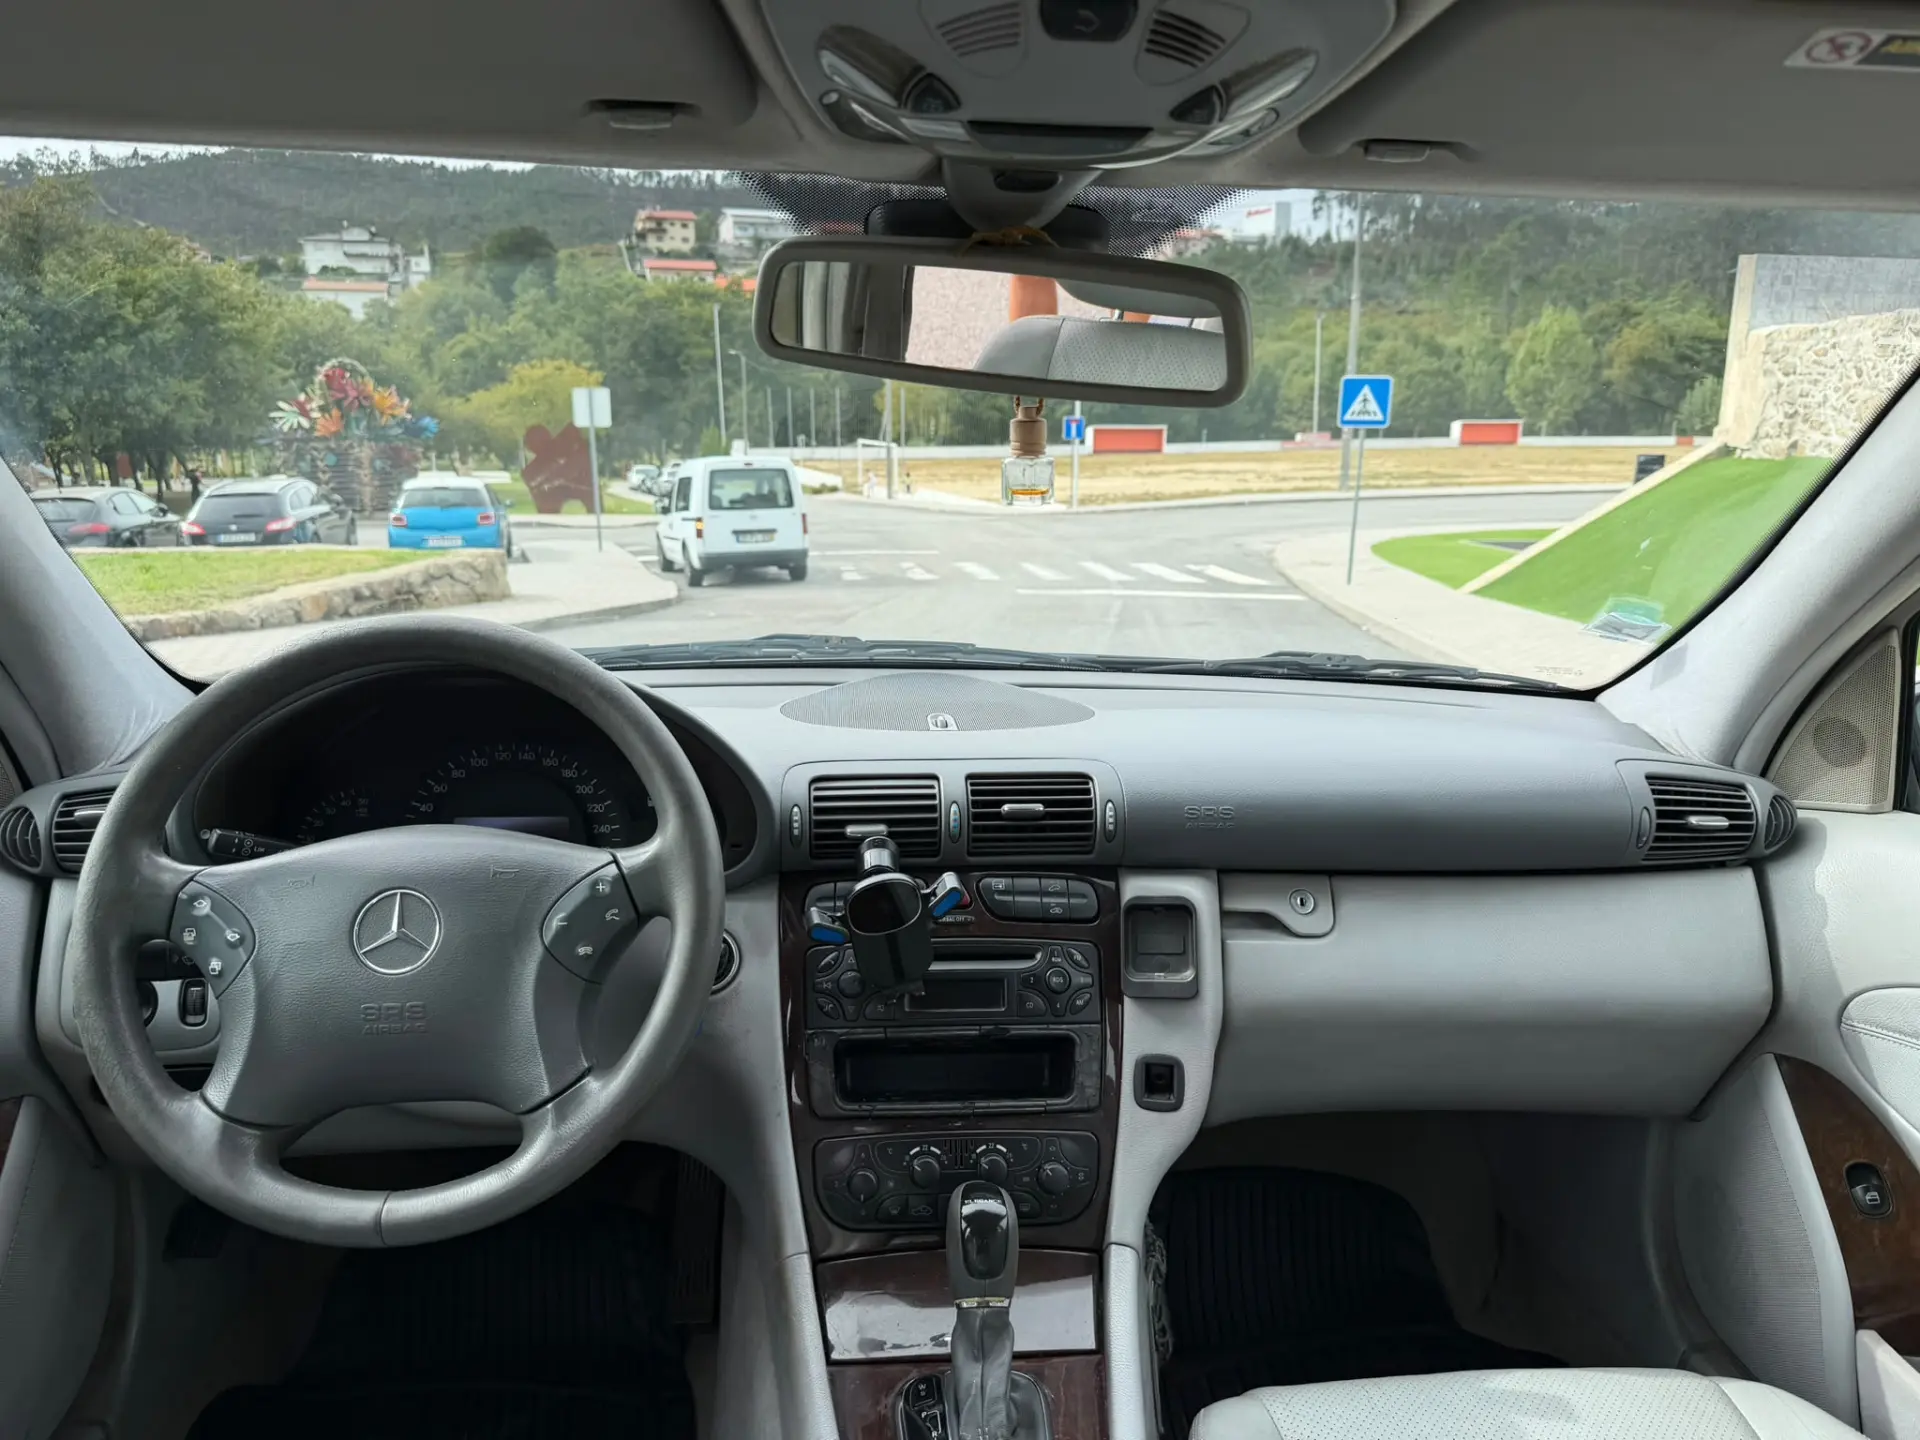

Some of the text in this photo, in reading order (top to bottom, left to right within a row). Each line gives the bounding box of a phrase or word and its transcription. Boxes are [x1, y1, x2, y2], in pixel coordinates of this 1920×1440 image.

[495, 751, 512, 762] 120
[518, 751, 536, 761] 140
[470, 757, 489, 767] 100
[542, 757, 559, 767] 160
[452, 769, 466, 778] 80
[561, 768, 578, 778] 180
[433, 783, 448, 793] 60
[575, 785, 594, 794] 200
[420, 802, 434, 812] 40
[587, 803, 605, 813] 220
[1184, 804, 1236, 819] SRS
[593, 824, 611, 834] 240
[1025, 1001, 1034, 1009] CD
[361, 1001, 427, 1020] SRS
